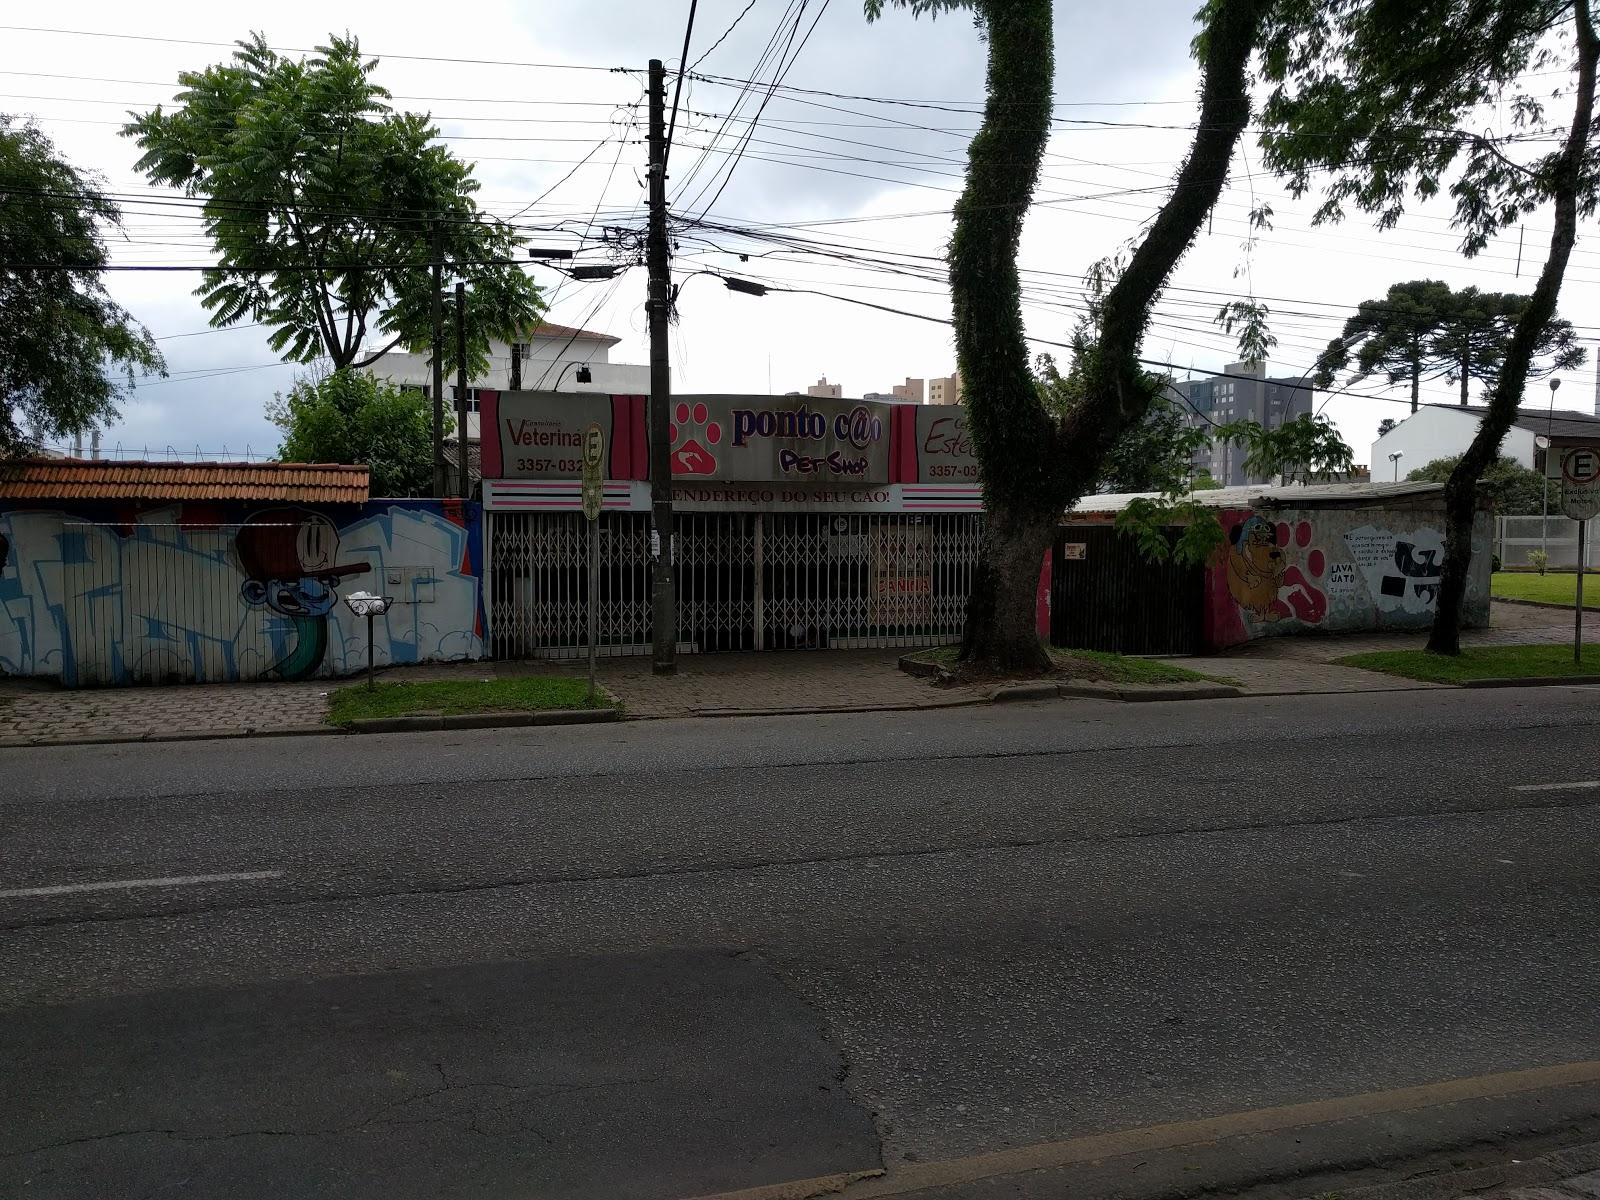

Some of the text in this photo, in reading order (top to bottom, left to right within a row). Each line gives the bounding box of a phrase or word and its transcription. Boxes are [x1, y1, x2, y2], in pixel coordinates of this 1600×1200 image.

[731, 404, 827, 447] ponto
[517, 458, 584, 472] 3357-032
[929, 465, 977, 477] 3357-03
[1573, 454, 1593, 477] E
[672, 489, 774, 505] ENDEREÇO
[781, 490, 807, 503] DO
[813, 490, 847, 503] SEU
[1331, 564, 1353, 574] LAVA
[1331, 574, 1355, 583] JATO
